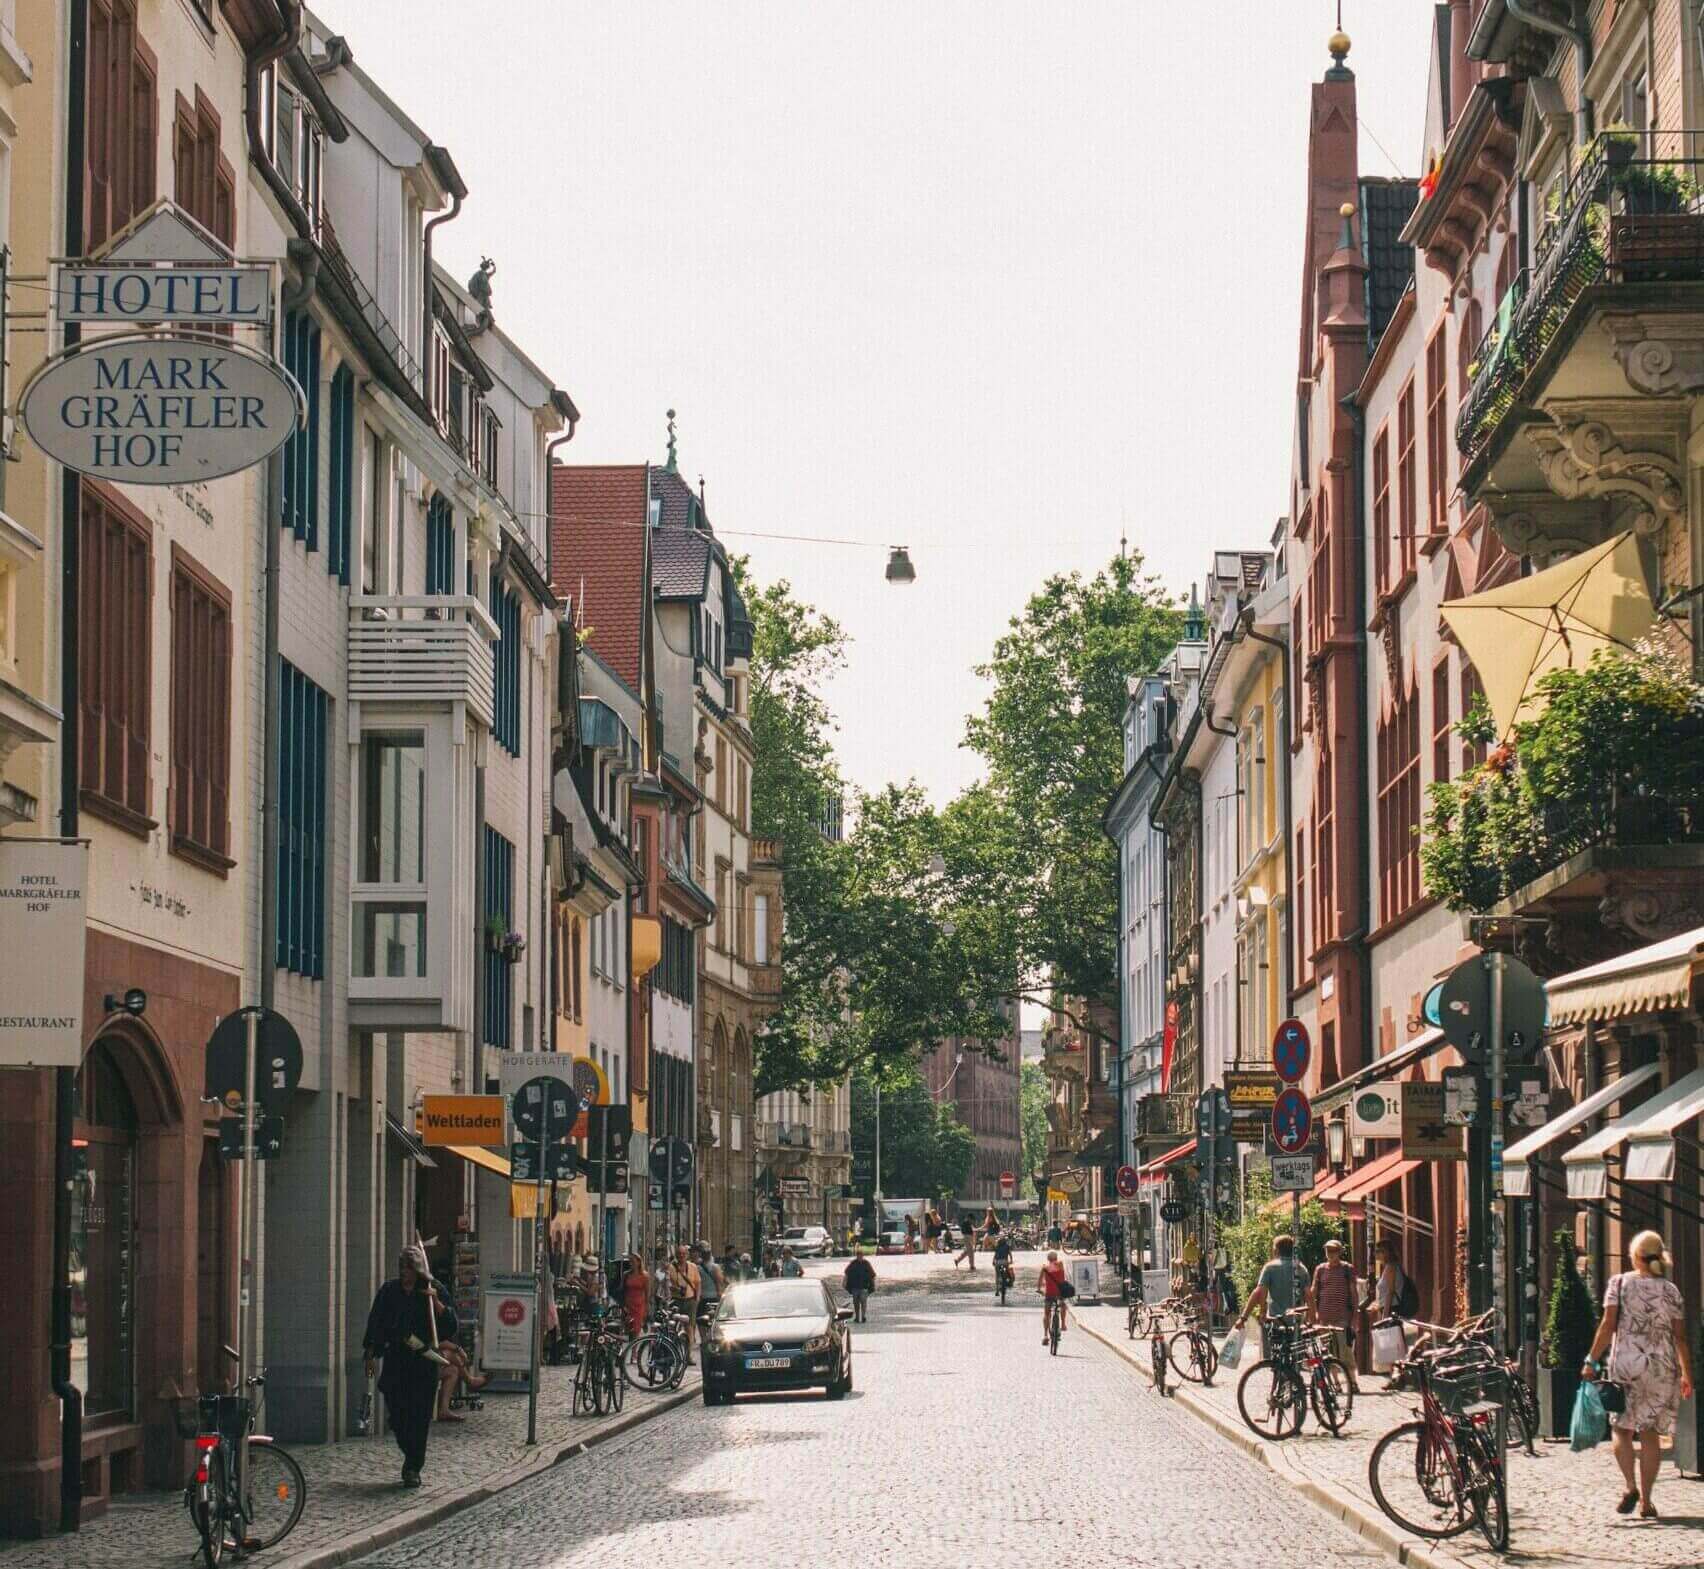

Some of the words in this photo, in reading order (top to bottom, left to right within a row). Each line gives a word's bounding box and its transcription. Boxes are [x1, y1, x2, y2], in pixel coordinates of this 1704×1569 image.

[69, 274, 260, 315] HOTEL
[94, 357, 229, 390] MARK
[60, 393, 268, 429] GRÄFLER
[91, 434, 183, 467] HOF
[21, 875, 58, 886] HOTEL
[27, 902, 52, 912] HOF
[1386, 1097, 1401, 1114] it
[427, 1113, 501, 1129] Weltladen
